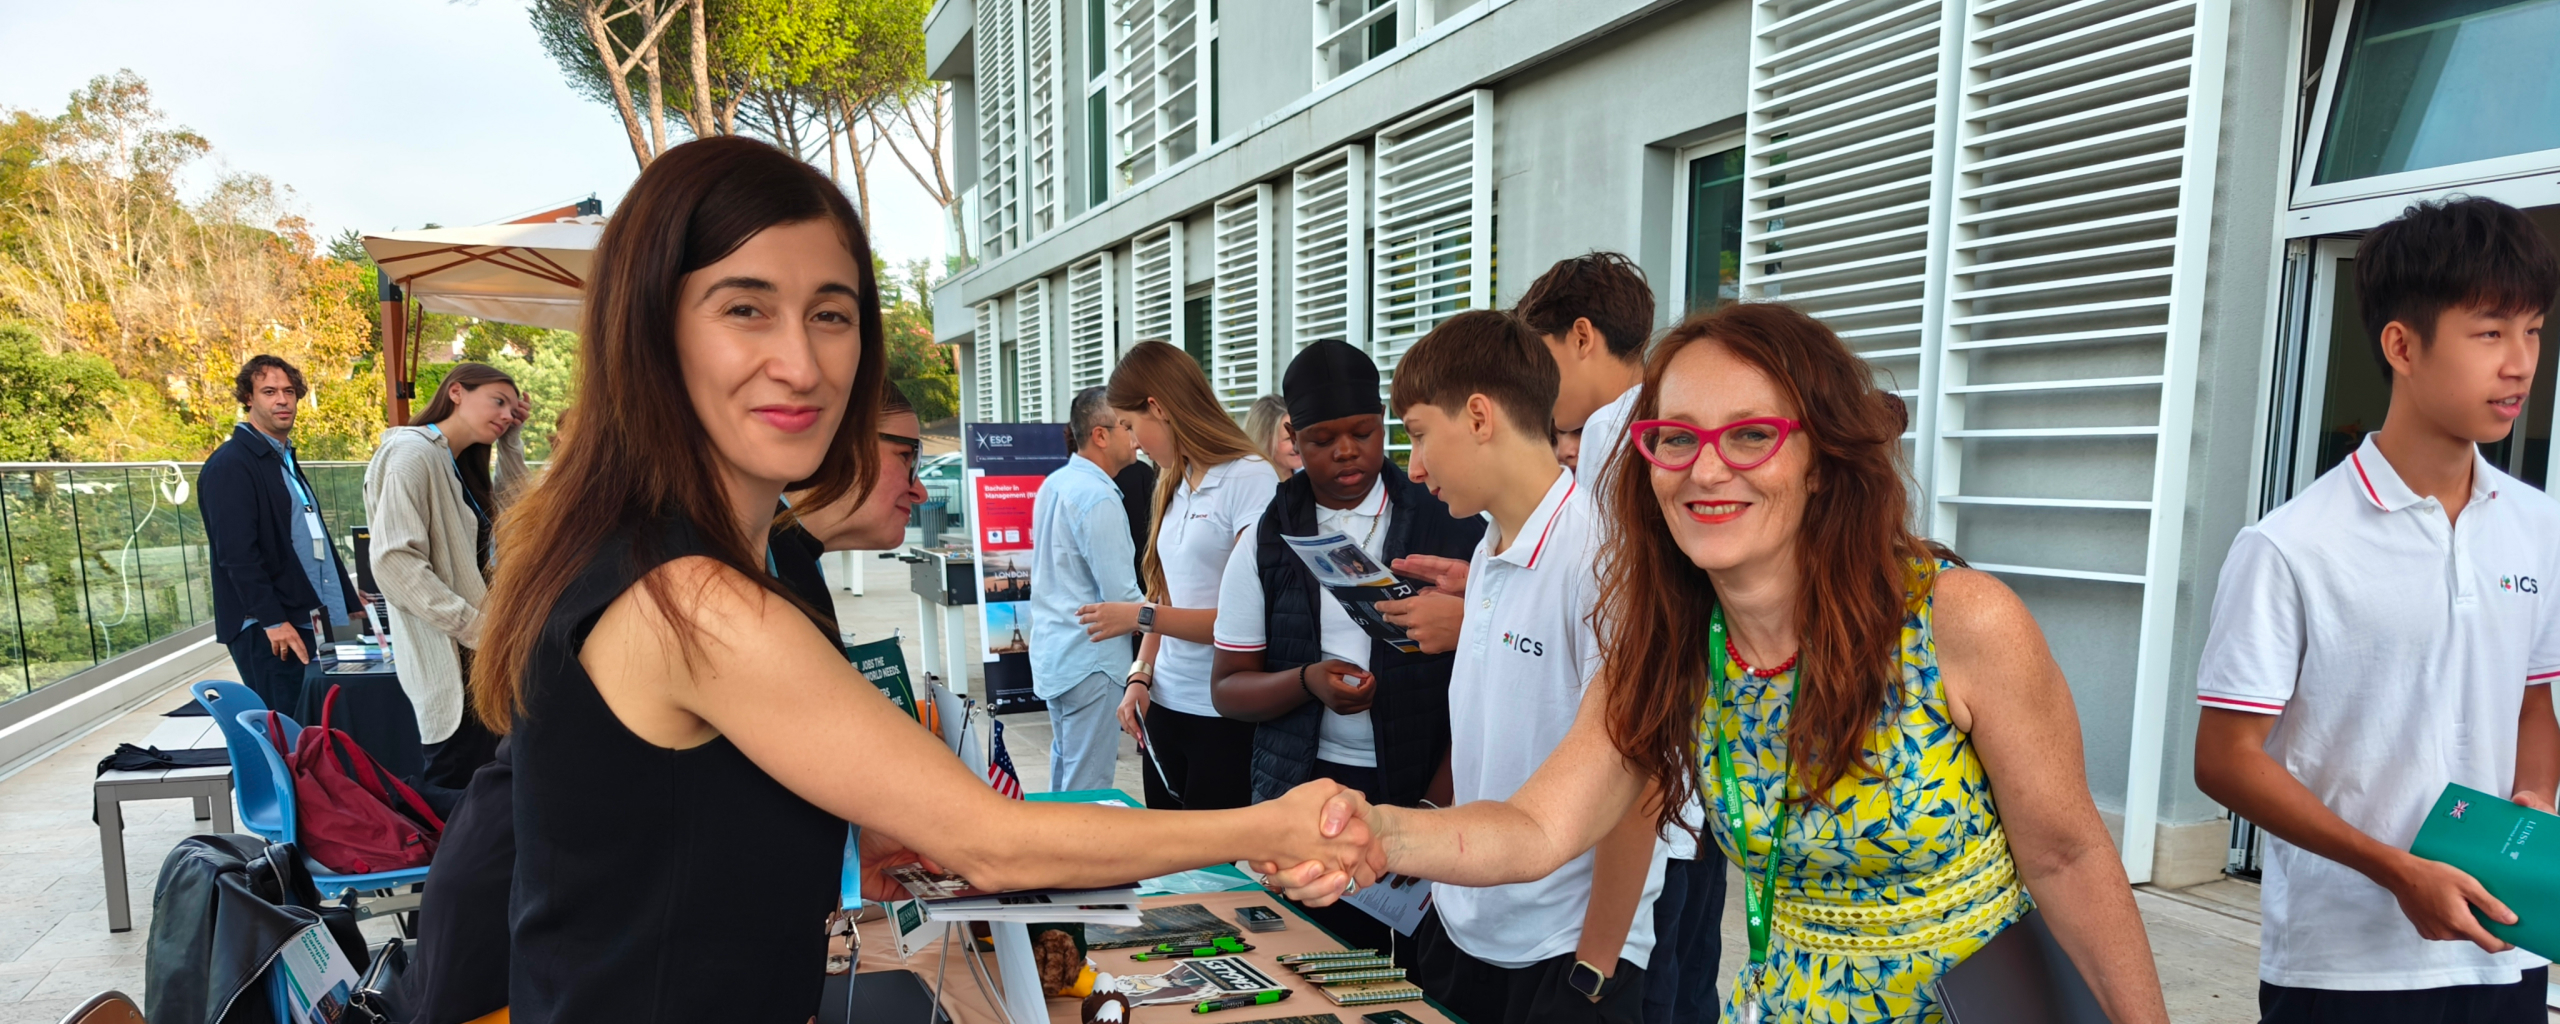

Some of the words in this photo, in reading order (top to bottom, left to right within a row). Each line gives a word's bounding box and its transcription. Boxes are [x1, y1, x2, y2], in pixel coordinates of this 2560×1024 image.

[990, 435, 1013, 444] ESCP
[985, 492, 1026, 500] Management
[994, 571, 1029, 579] LONDON
[862, 658, 875, 671] JOBS
[874, 656, 885, 668] THE
[863, 669, 883, 681] WORLD
[882, 664, 901, 678] NEEDS.
[1725, 777, 1737, 815] RISROME
[2516, 820, 2537, 845] LUISS
[301, 936, 325, 974] Germany
[309, 929, 330, 960] Munich
[1200, 960, 1261, 990] EAGLES
